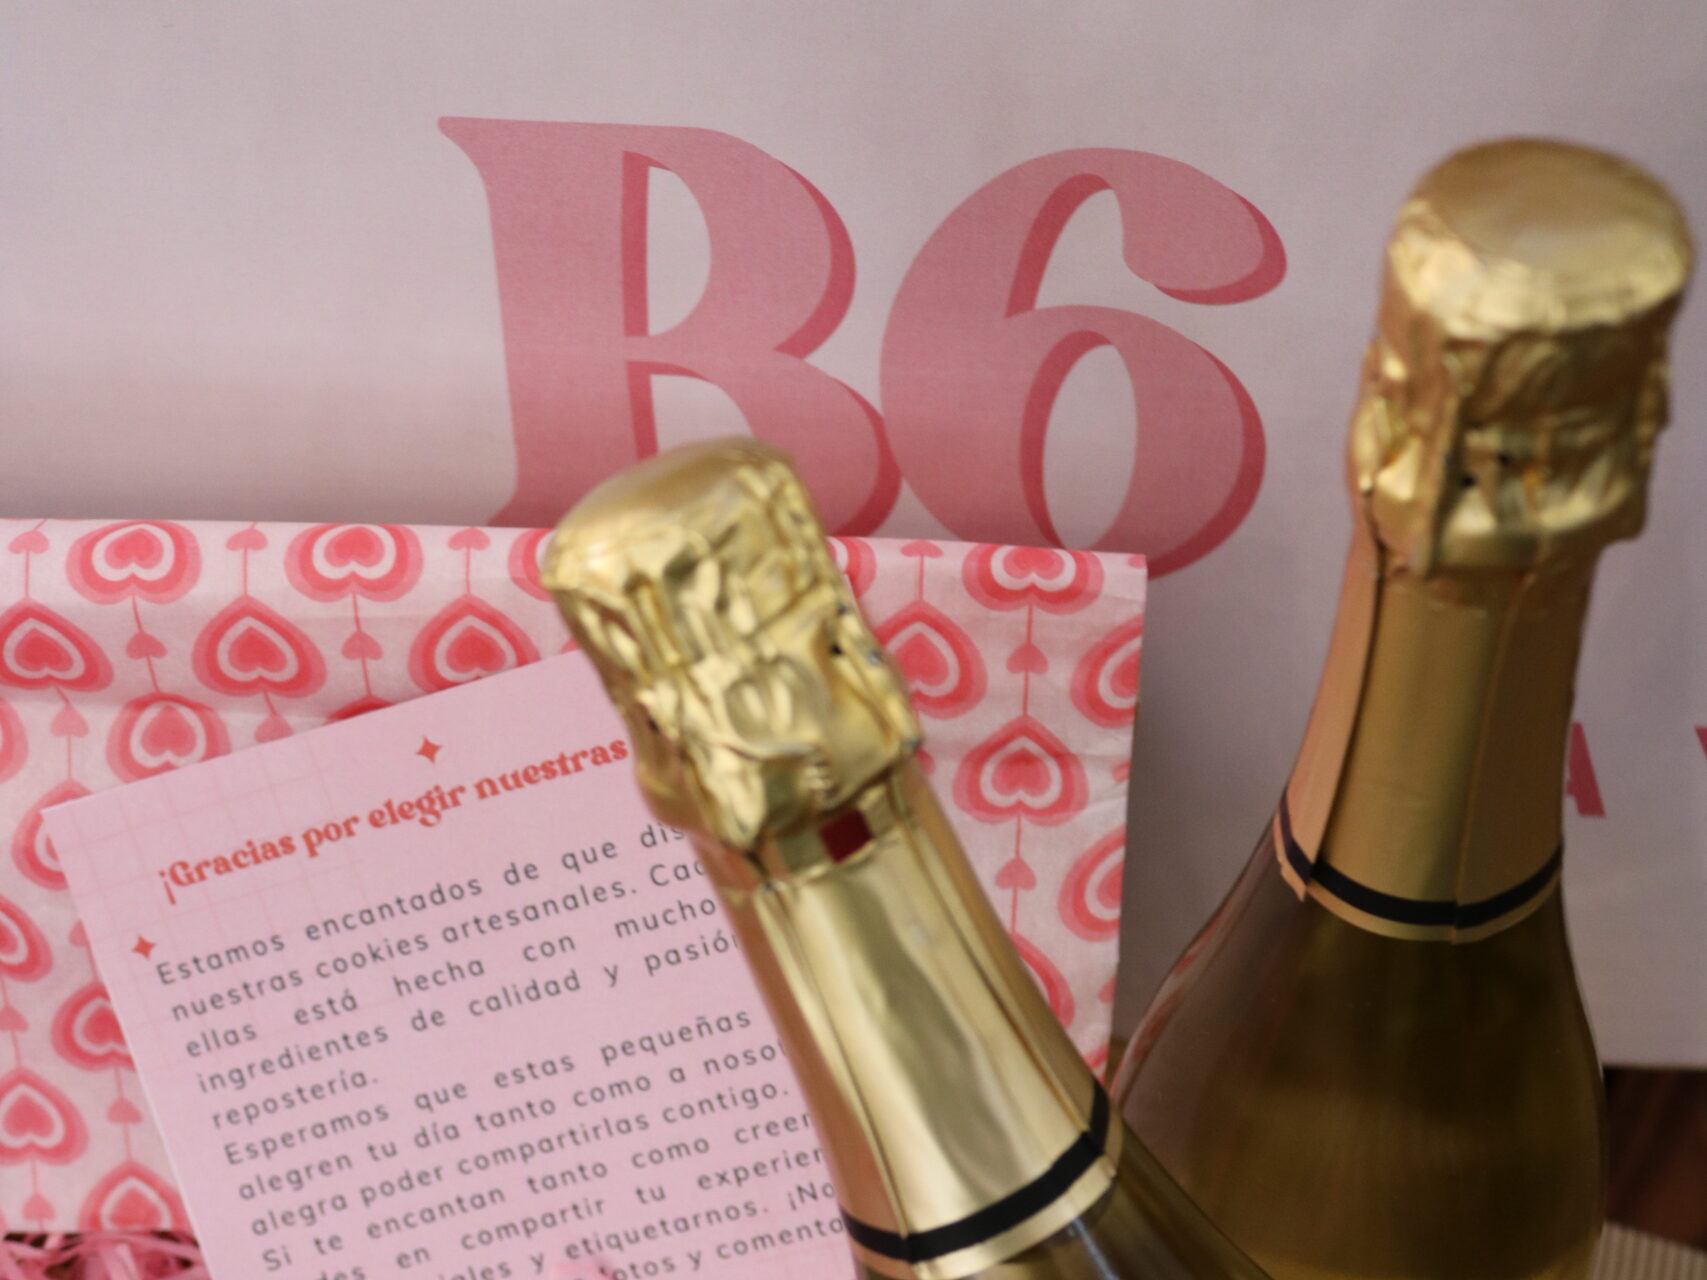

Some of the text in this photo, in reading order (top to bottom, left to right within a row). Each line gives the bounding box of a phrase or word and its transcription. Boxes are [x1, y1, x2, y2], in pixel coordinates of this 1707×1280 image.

[437, 115, 1288, 579] B6
[158, 739, 629, 906] ¡Gracias por elegir nuestras
[156, 933, 285, 986] Estamos
[305, 878, 483, 942] encantados
[503, 861, 540, 886] de
[560, 841, 618, 874] que
[171, 969, 304, 1021] nuestras
[315, 934, 429, 979] cookies
[441, 880, 637, 944] artesanales.
[185, 898, 716, 1058] ellas está hecha con mucho
[199, 923, 740, 1093] ingredientes de calidad y pasió
[212, 1070, 379, 1129] repostería.
[223, 1011, 751, 1166] Esperamos que estas pequeñas
[238, 1040, 786, 1201] alegren tu día tanto como a noso
[251, 1083, 788, 1236] alegra poder compartirlas contigo.
[262, 1248, 292, 1271] Si
[313, 1234, 343, 1255] te
[366, 1188, 506, 1240] encantan
[526, 1162, 608, 1195] tanto
[631, 1137, 710, 1169] como
[396, 1247, 430, 1269] en
[460, 1198, 604, 1251] compartir
[635, 1186, 667, 1205] tu
[530, 1253, 544, 1275] y
[565, 1201, 768, 1260] etiquetarnos.
[687, 1251, 702, 1272] y
